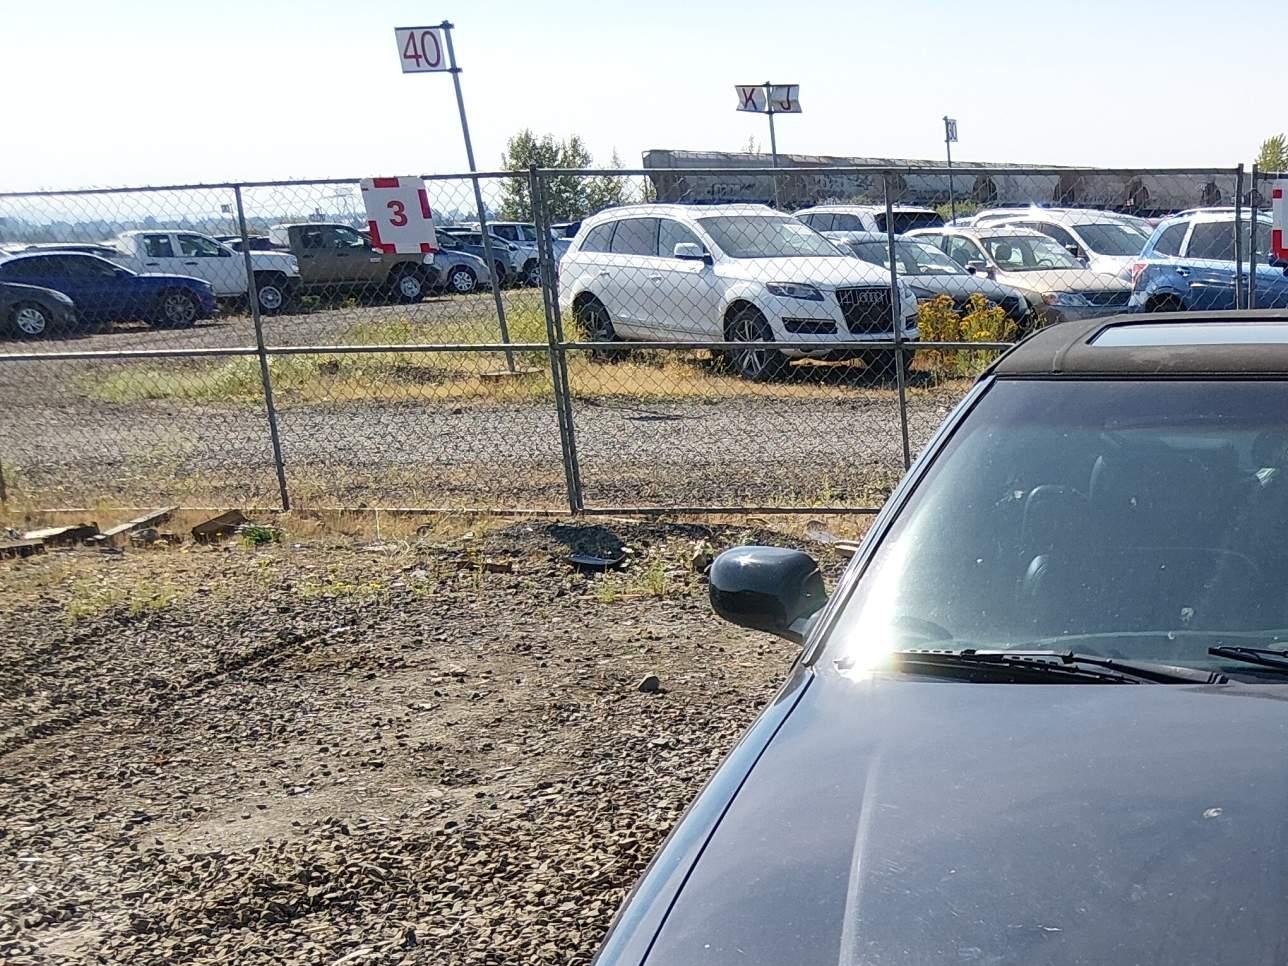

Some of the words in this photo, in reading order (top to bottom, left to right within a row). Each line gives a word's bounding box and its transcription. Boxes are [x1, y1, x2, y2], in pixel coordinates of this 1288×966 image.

[403, 30, 441, 68] 40
[742, 87, 758, 110] K
[780, 87, 791, 110] J
[387, 200, 408, 227] 3
